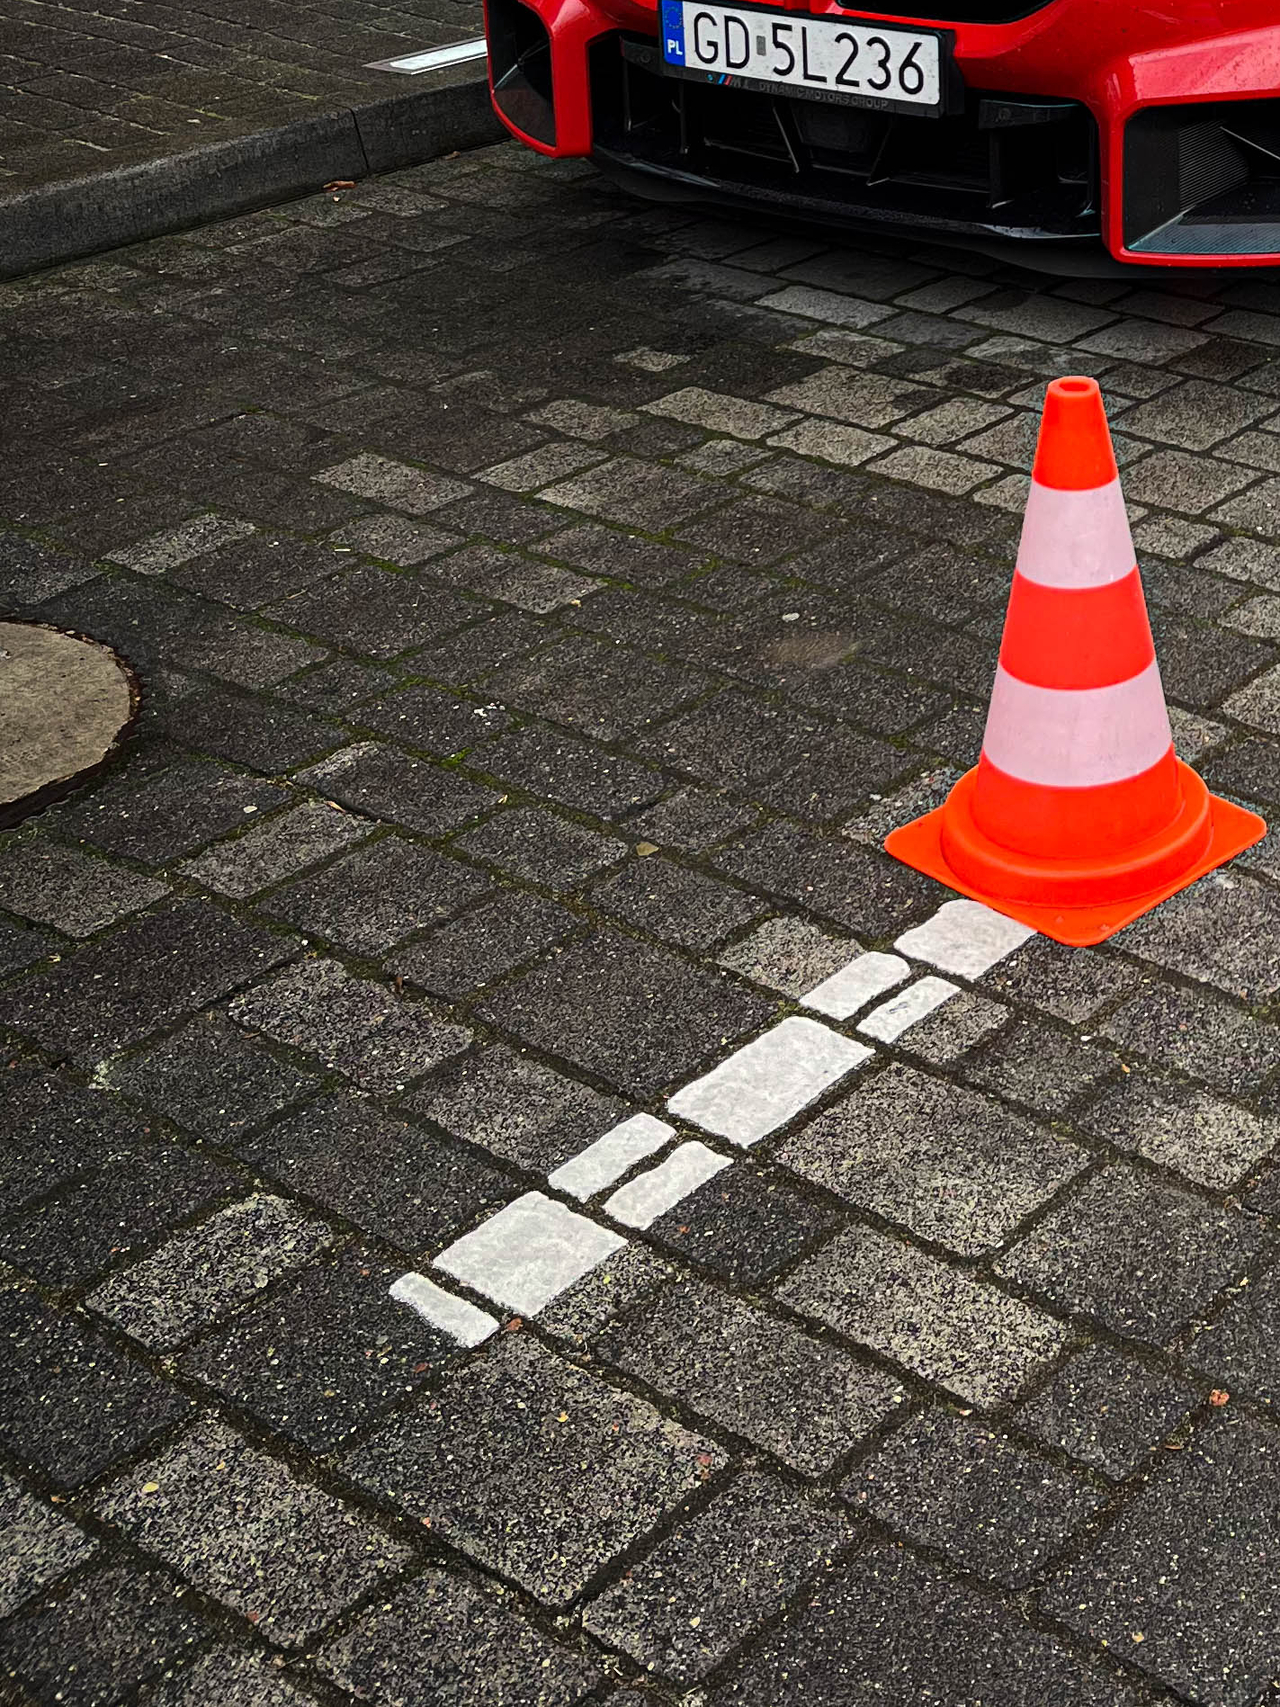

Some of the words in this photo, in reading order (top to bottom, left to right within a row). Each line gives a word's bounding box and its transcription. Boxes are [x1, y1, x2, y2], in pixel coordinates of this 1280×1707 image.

[667, 40, 683, 56] PL
[693, 11, 752, 70] GD
[772, 22, 924, 95] 5L236
[759, 82, 805, 97] DYNAMIC
[805, 89, 850, 105] MOTORS
[851, 96, 889, 109] GROUP
